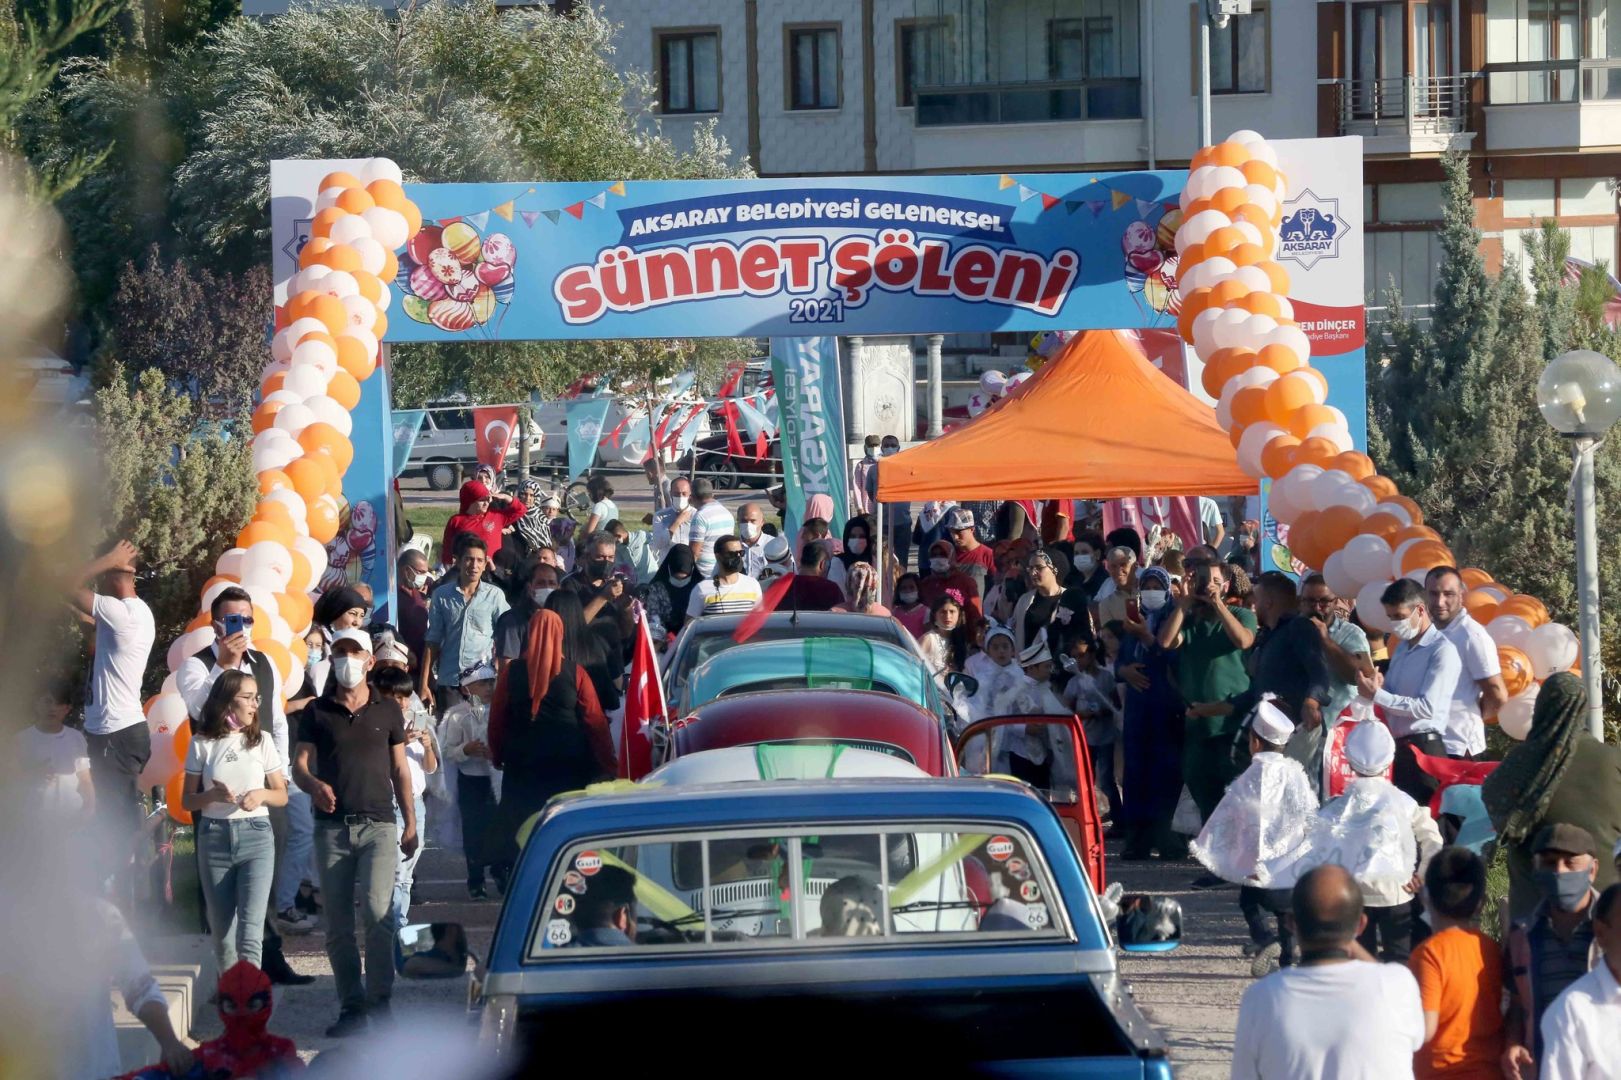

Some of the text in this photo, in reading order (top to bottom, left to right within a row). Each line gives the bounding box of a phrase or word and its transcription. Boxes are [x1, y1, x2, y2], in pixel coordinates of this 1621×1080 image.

[629, 206, 732, 237] AKSARAY
[1283, 241, 1332, 251] AKSARAY
[790, 300, 844, 323] 2021
[1317, 319, 1356, 332] DİNÇER
[1028, 912, 1043, 922] 66
[551, 928, 567, 940] 66
